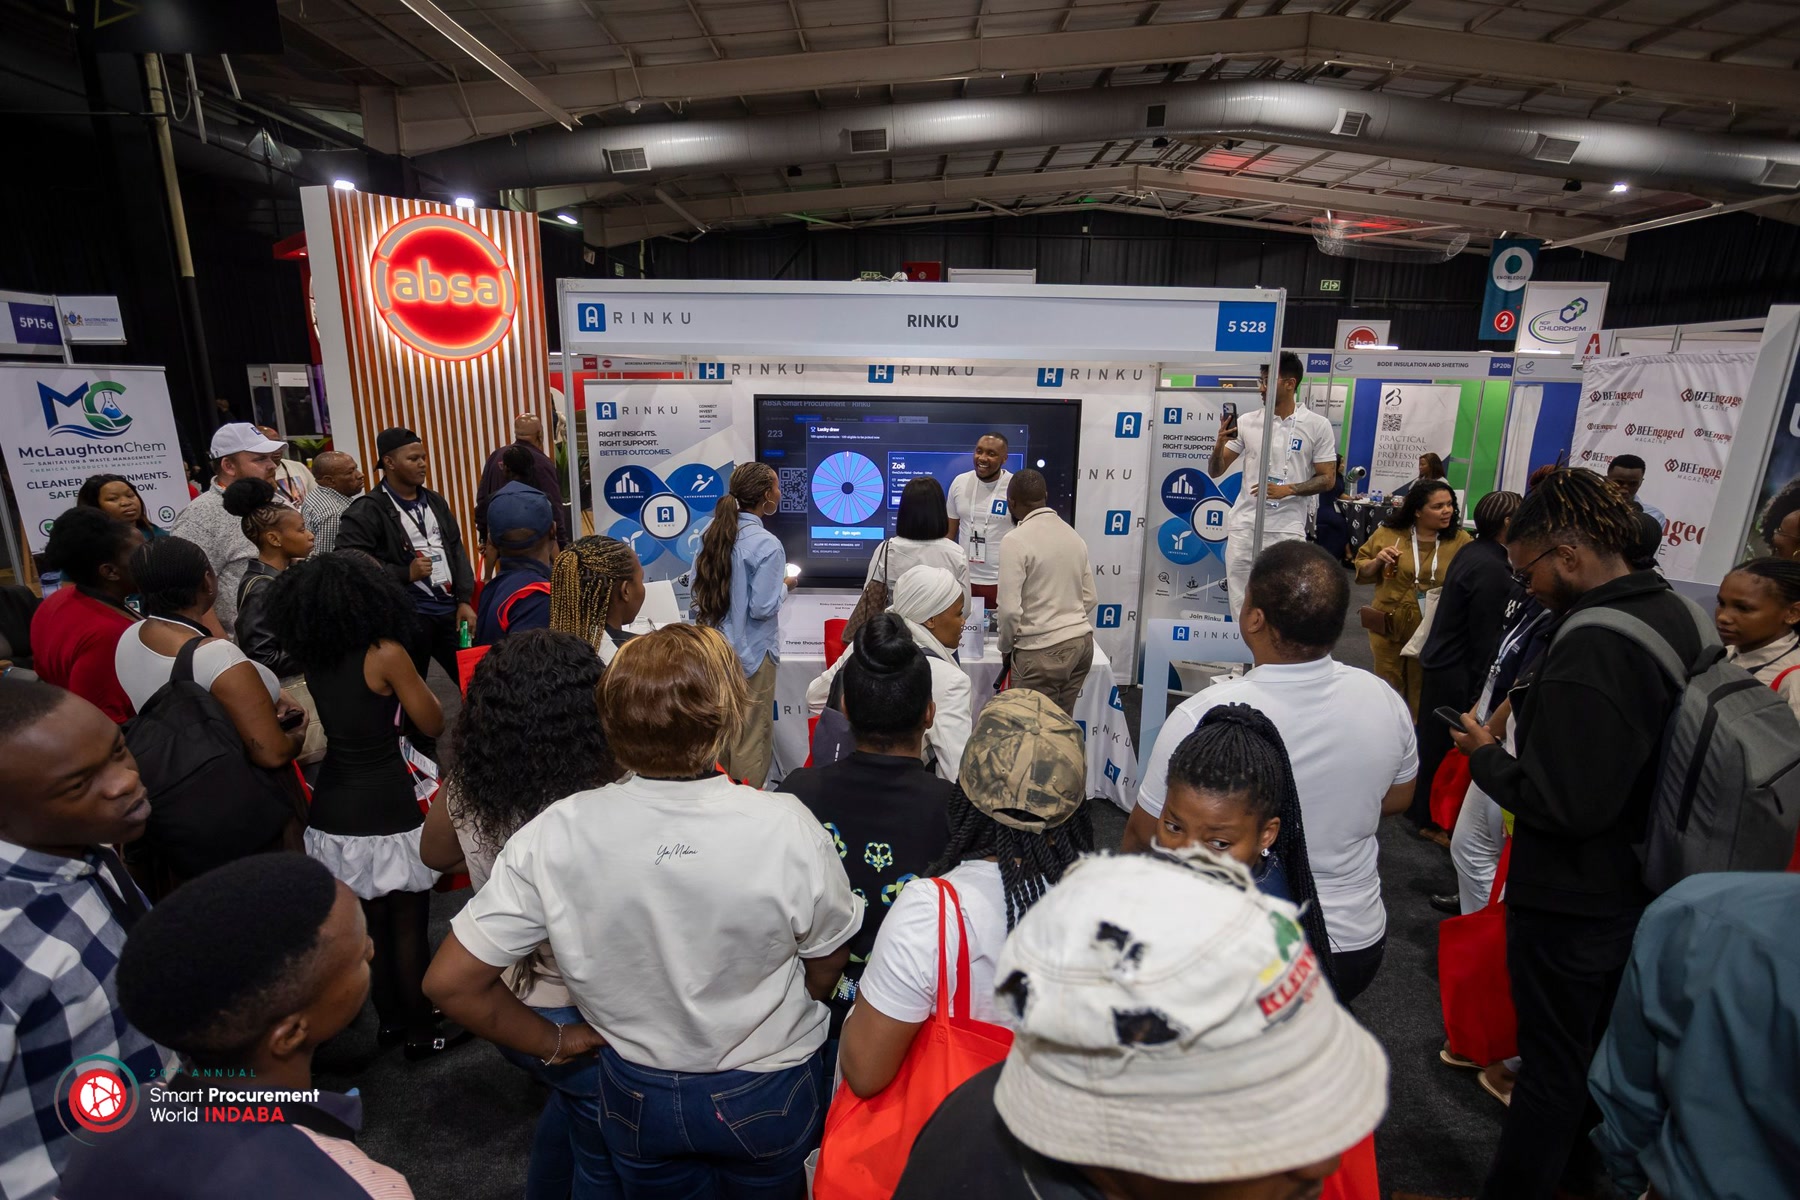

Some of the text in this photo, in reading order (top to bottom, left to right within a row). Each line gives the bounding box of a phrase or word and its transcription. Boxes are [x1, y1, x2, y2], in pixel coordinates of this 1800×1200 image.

[393, 258, 500, 306] absa
[19, 317, 54, 329] 5P15e
[613, 311, 692, 325] RINKU
[907, 314, 960, 329] RINKU
[1500, 315, 1508, 328] 2
[1227, 320, 1267, 333] 5 S28
[731, 363, 805, 375] RINKU
[901, 366, 975, 377] RINKU
[1070, 368, 1143, 381] RINKU
[1694, 390, 1743, 406] BEEngage
[621, 406, 679, 415] RINKU
[767, 429, 783, 438] 223
[1636, 425, 1685, 440] BEEngaged
[622, 439, 659, 447] SUPPORT.
[1379, 434, 1427, 444] PRACTICAL
[1634, 437, 1667, 445] MAGAZINE
[18, 441, 167, 460] McLaughtonChem
[112, 454, 155, 462] MANAGEMENT
[1591, 451, 1614, 464] BEEng
[891, 462, 906, 470] Zoë
[1679, 462, 1722, 480] BEEngag
[1077, 468, 1133, 480] INKU
[1677, 474, 1715, 485] MAGAZINE
[26, 476, 83, 490] CLEANER
[48, 489, 79, 500] SAFE
[1203, 614, 1222, 622] Rinku
[1193, 630, 1240, 640] RINKU
